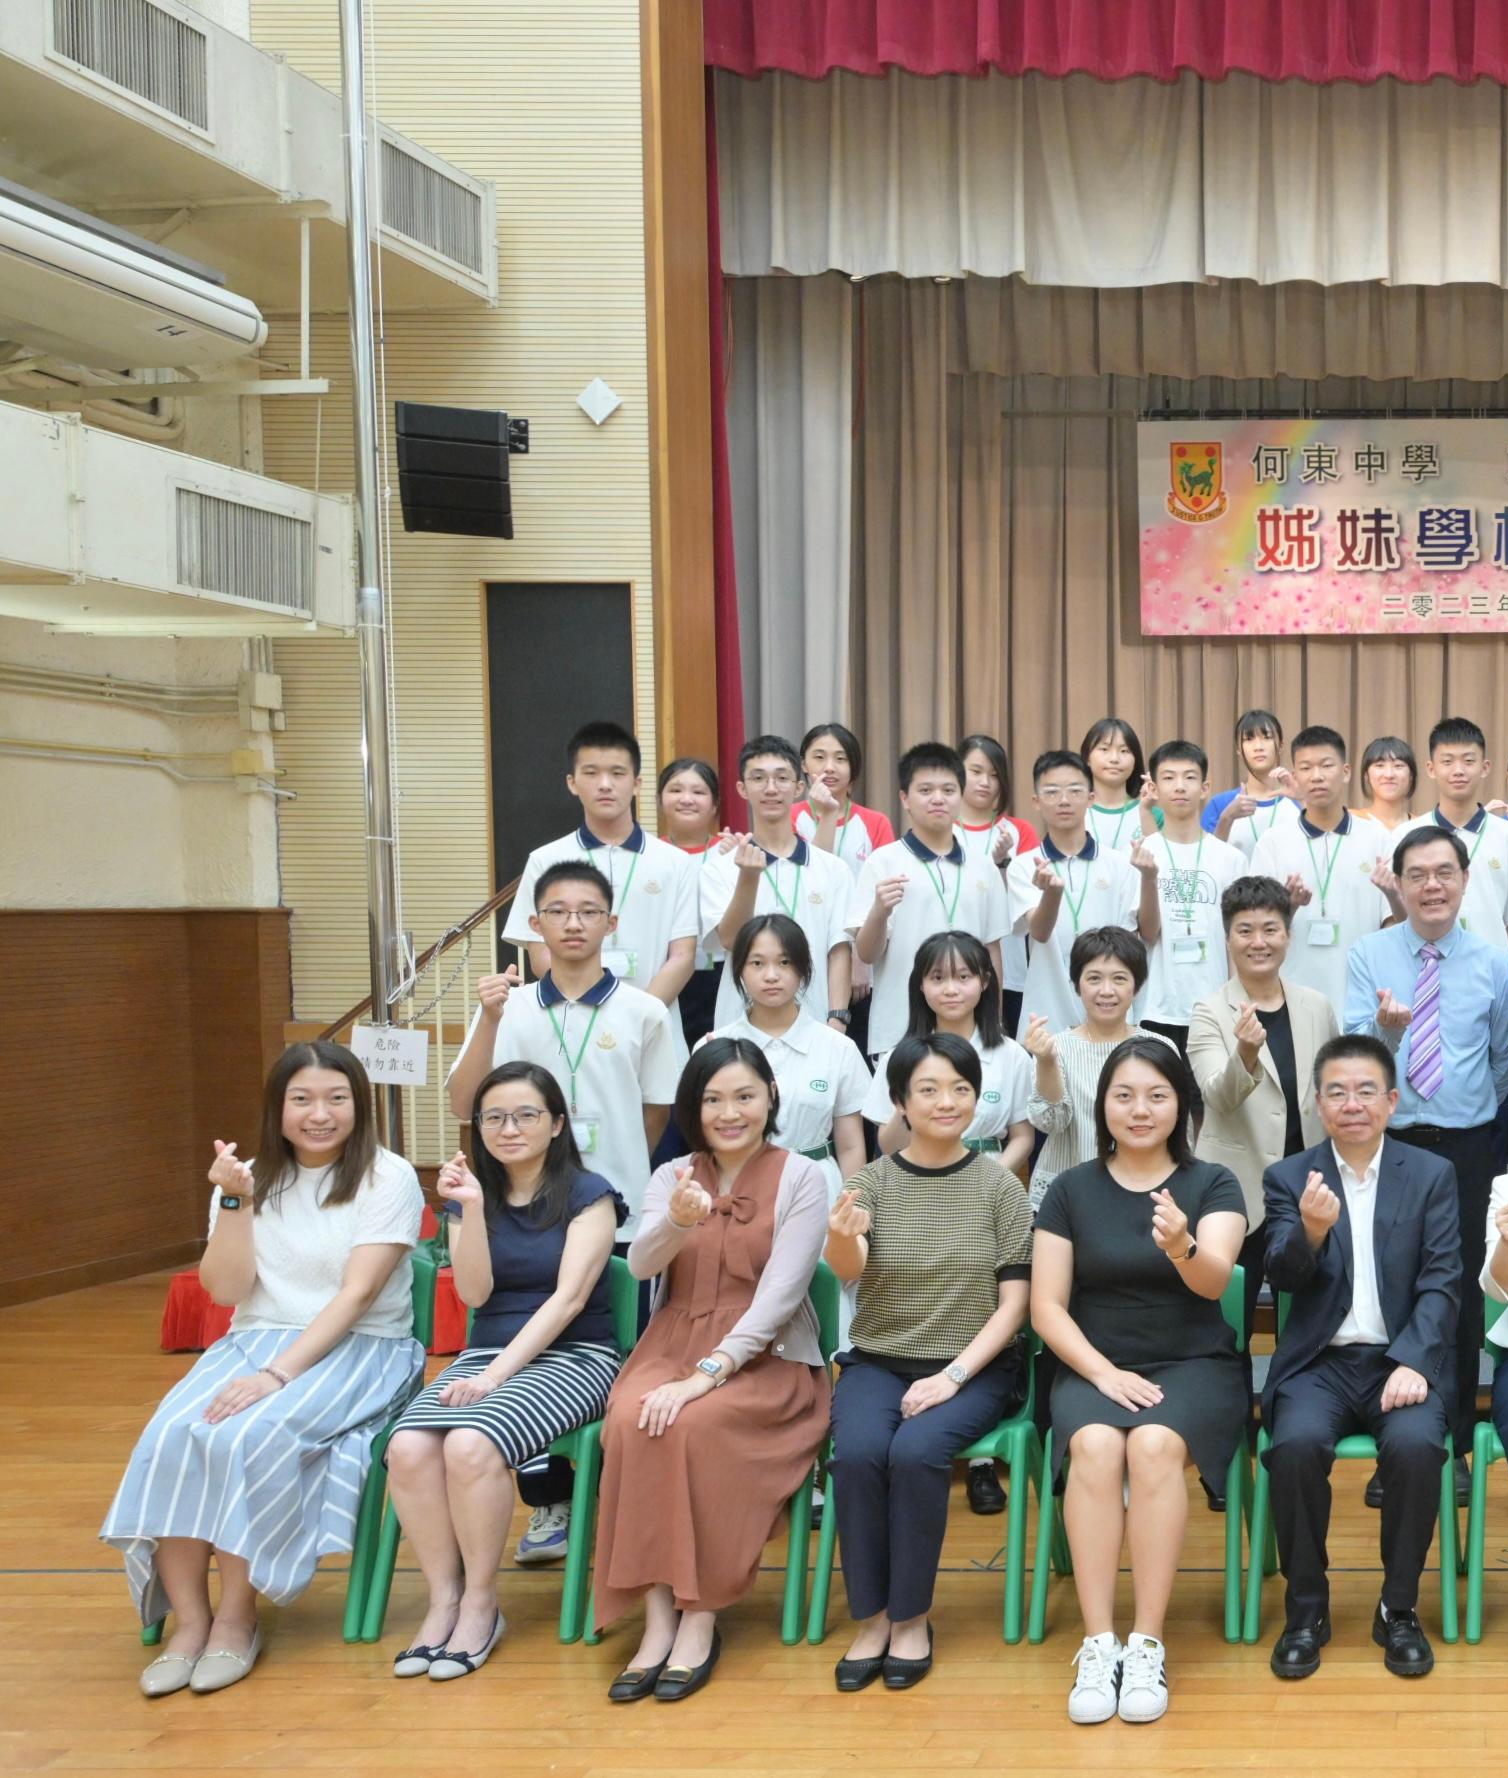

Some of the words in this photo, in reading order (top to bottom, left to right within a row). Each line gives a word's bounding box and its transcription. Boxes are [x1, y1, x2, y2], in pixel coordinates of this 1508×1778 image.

[1251, 443, 1438, 482] 何東中學
[375, 1038, 401, 1051] 危險
